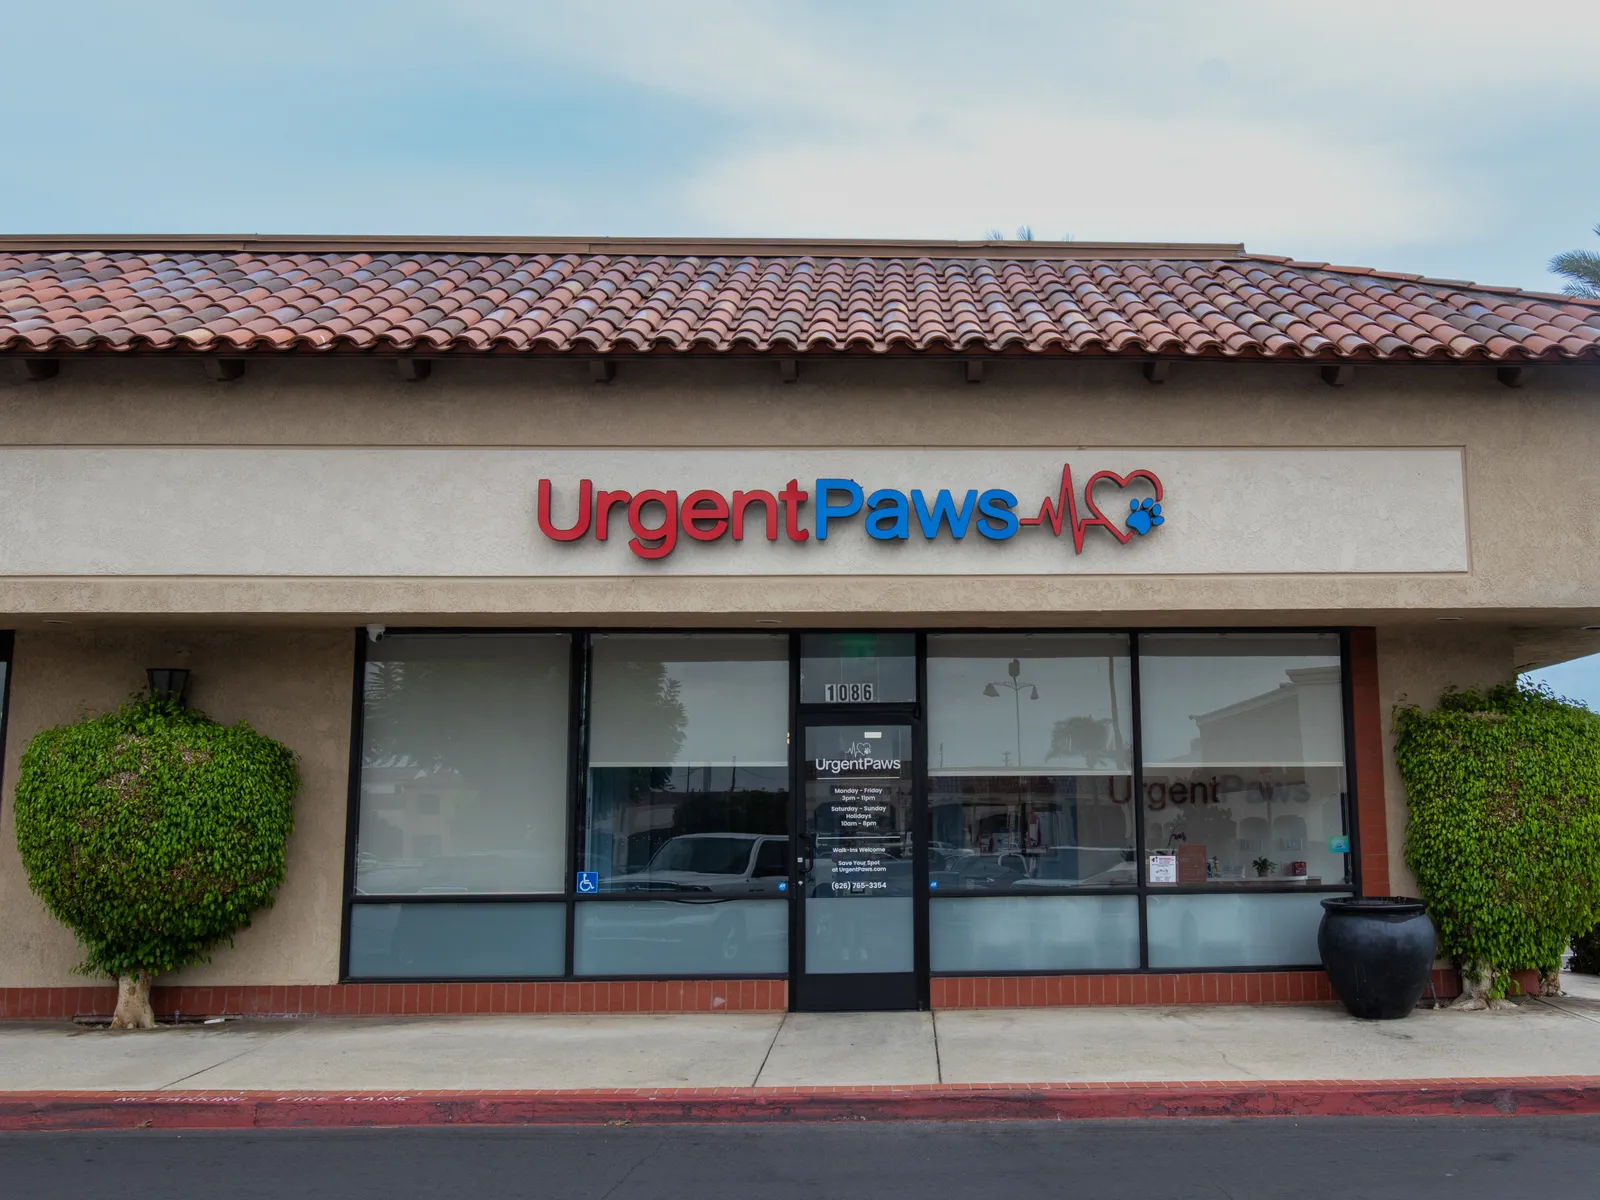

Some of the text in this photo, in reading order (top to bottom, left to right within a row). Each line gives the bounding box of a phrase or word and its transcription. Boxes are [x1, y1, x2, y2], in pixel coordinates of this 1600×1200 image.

[538, 478, 1018, 559] UrgentPaws
[827, 684, 872, 701] 1086
[816, 758, 901, 773] UrgentPaws
[832, 882, 850, 890] (626)
